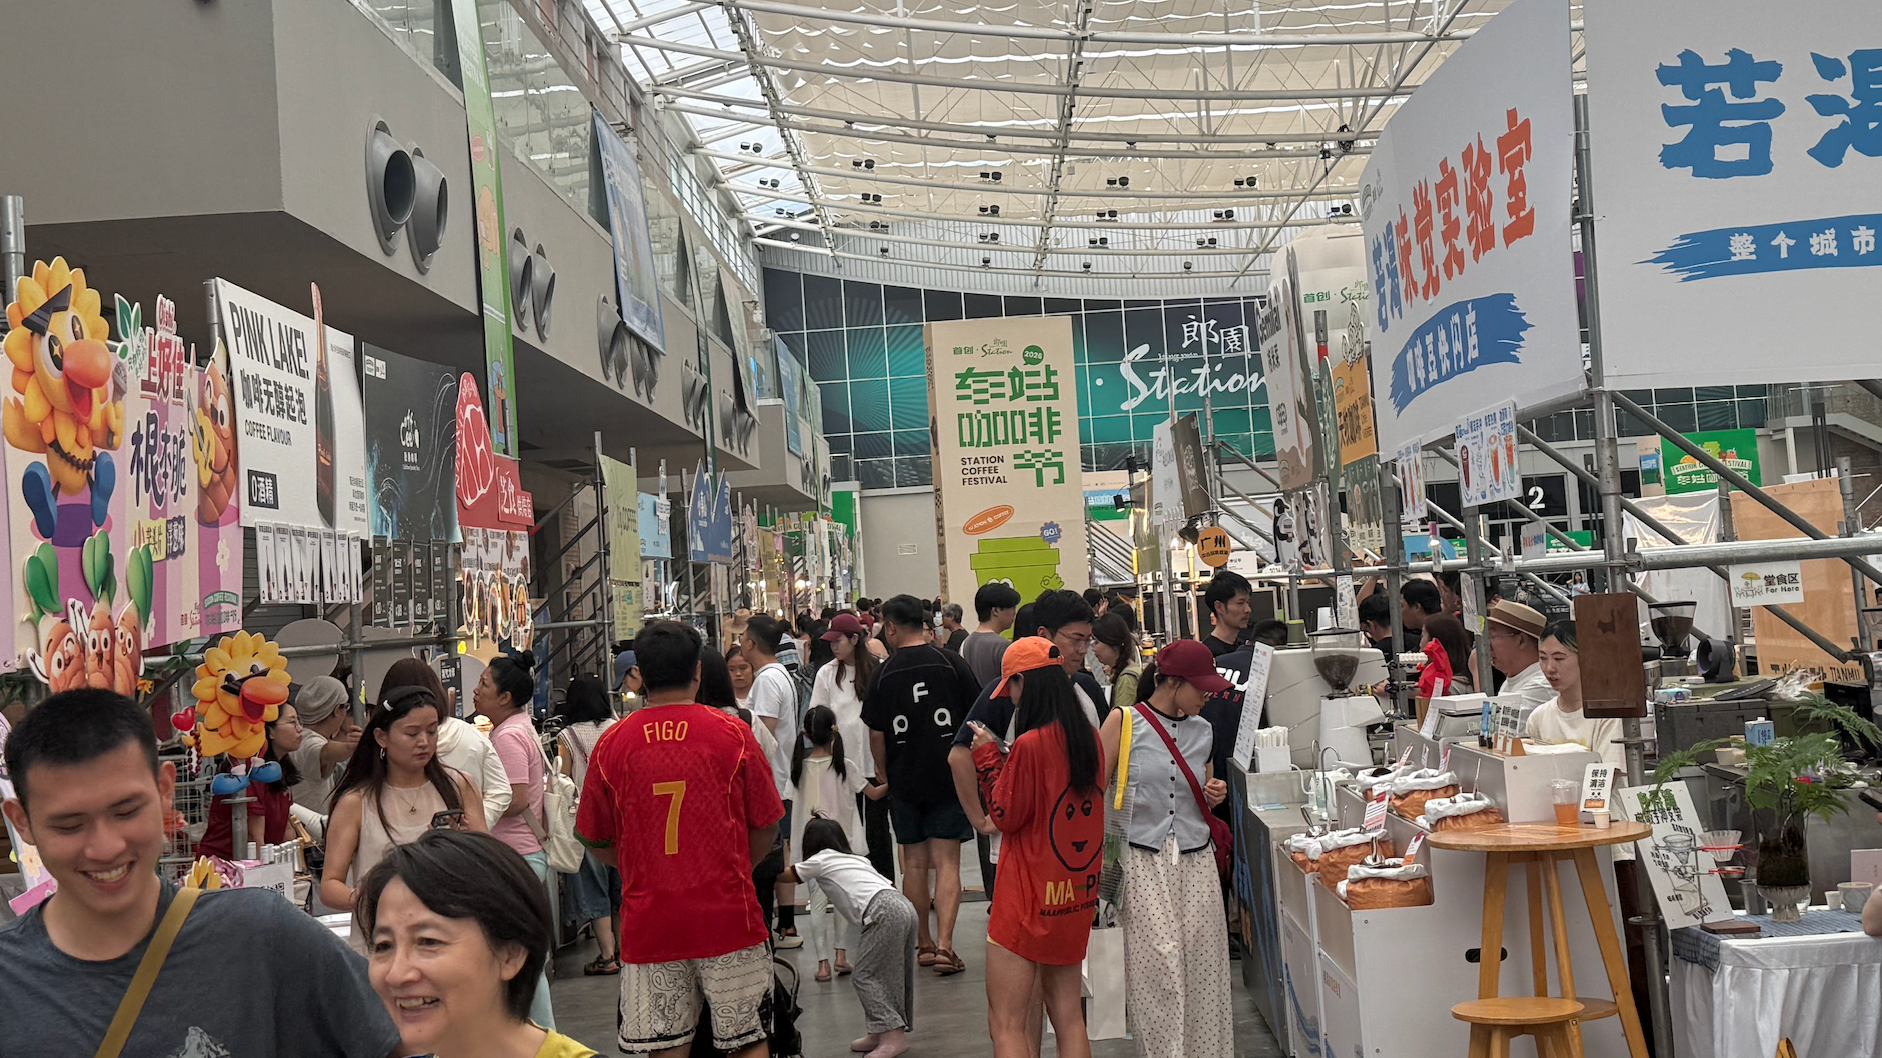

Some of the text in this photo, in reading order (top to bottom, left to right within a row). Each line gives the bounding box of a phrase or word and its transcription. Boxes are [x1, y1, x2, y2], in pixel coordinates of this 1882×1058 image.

[1728, 225, 1876, 261] 整个城市
[1340, 287, 1370, 304] Statio
[229, 301, 310, 380] PINK LAKE!
[981, 343, 1013, 358] Station
[141, 332, 184, 399] 上好佳
[1119, 343, 1267, 411] Station
[955, 364, 1060, 405] 车站
[244, 419, 292, 447] COFFEE FLAVOUR
[957, 406, 1062, 448] 咖啡
[130, 412, 188, 508] 根本脆
[960, 455, 1005, 466] STATION
[961, 466, 999, 476] COFFEE
[1013, 449, 1065, 487] 节
[962, 475, 1008, 486] FESTIVAL
[1528, 486, 1546, 510] 2
[1043, 527, 1058, 537] GO!
[1200, 535, 1226, 551] 广州
[1764, 572, 1800, 587] 堂食区
[913, 682, 929, 703] F
[642, 720, 689, 744] FIGO
[1589, 779, 1607, 788] 清洁
[1591, 768, 1608, 778] 保持
[652, 780, 687, 855] 7
